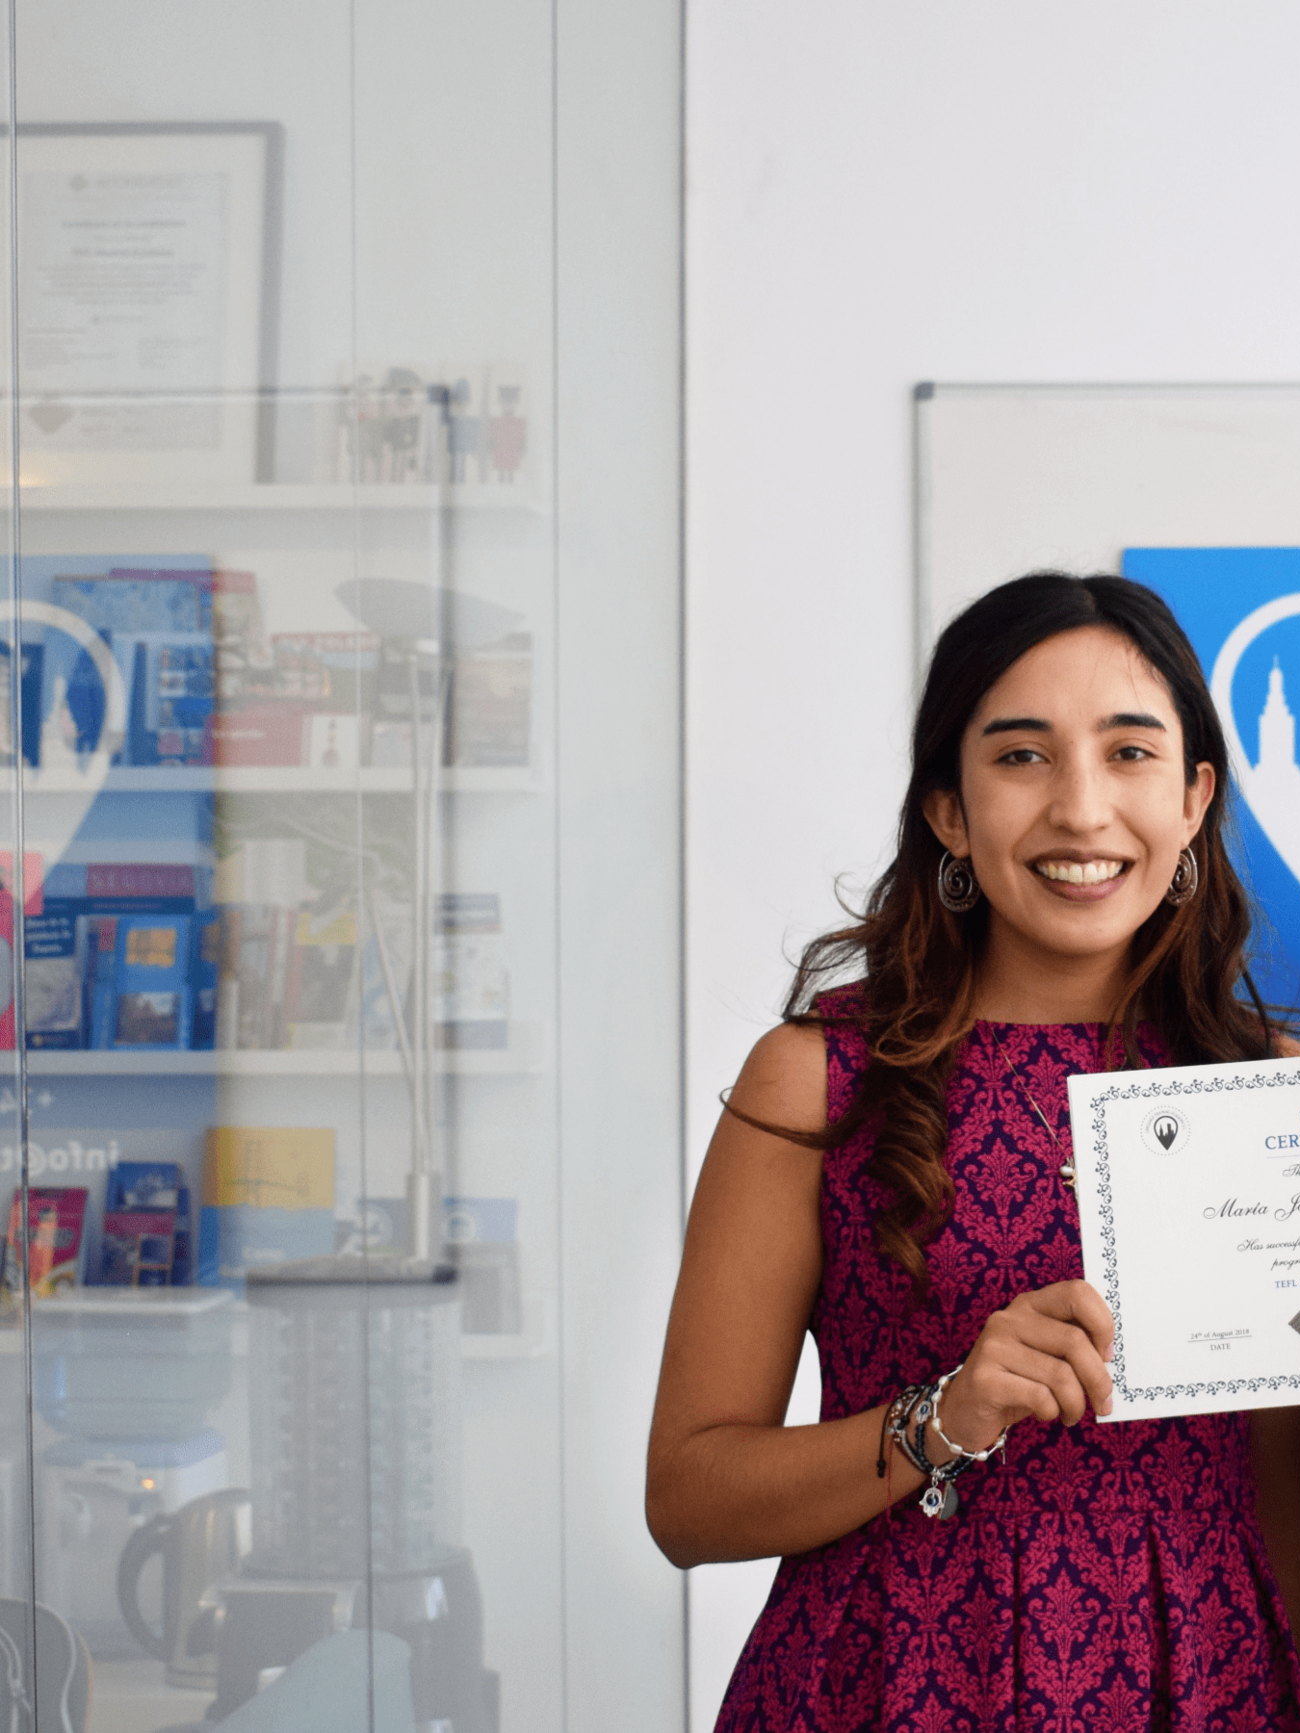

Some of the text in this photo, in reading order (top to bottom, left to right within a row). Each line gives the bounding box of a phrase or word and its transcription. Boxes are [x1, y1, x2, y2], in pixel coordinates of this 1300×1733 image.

[1236, 1238, 1264, 1252] Has
[1274, 1279, 1298, 1289] TEFL
[1211, 1330, 1234, 1339] August
[1234, 1328, 1250, 1336] 2018
[1210, 1342, 1231, 1351] DATE
